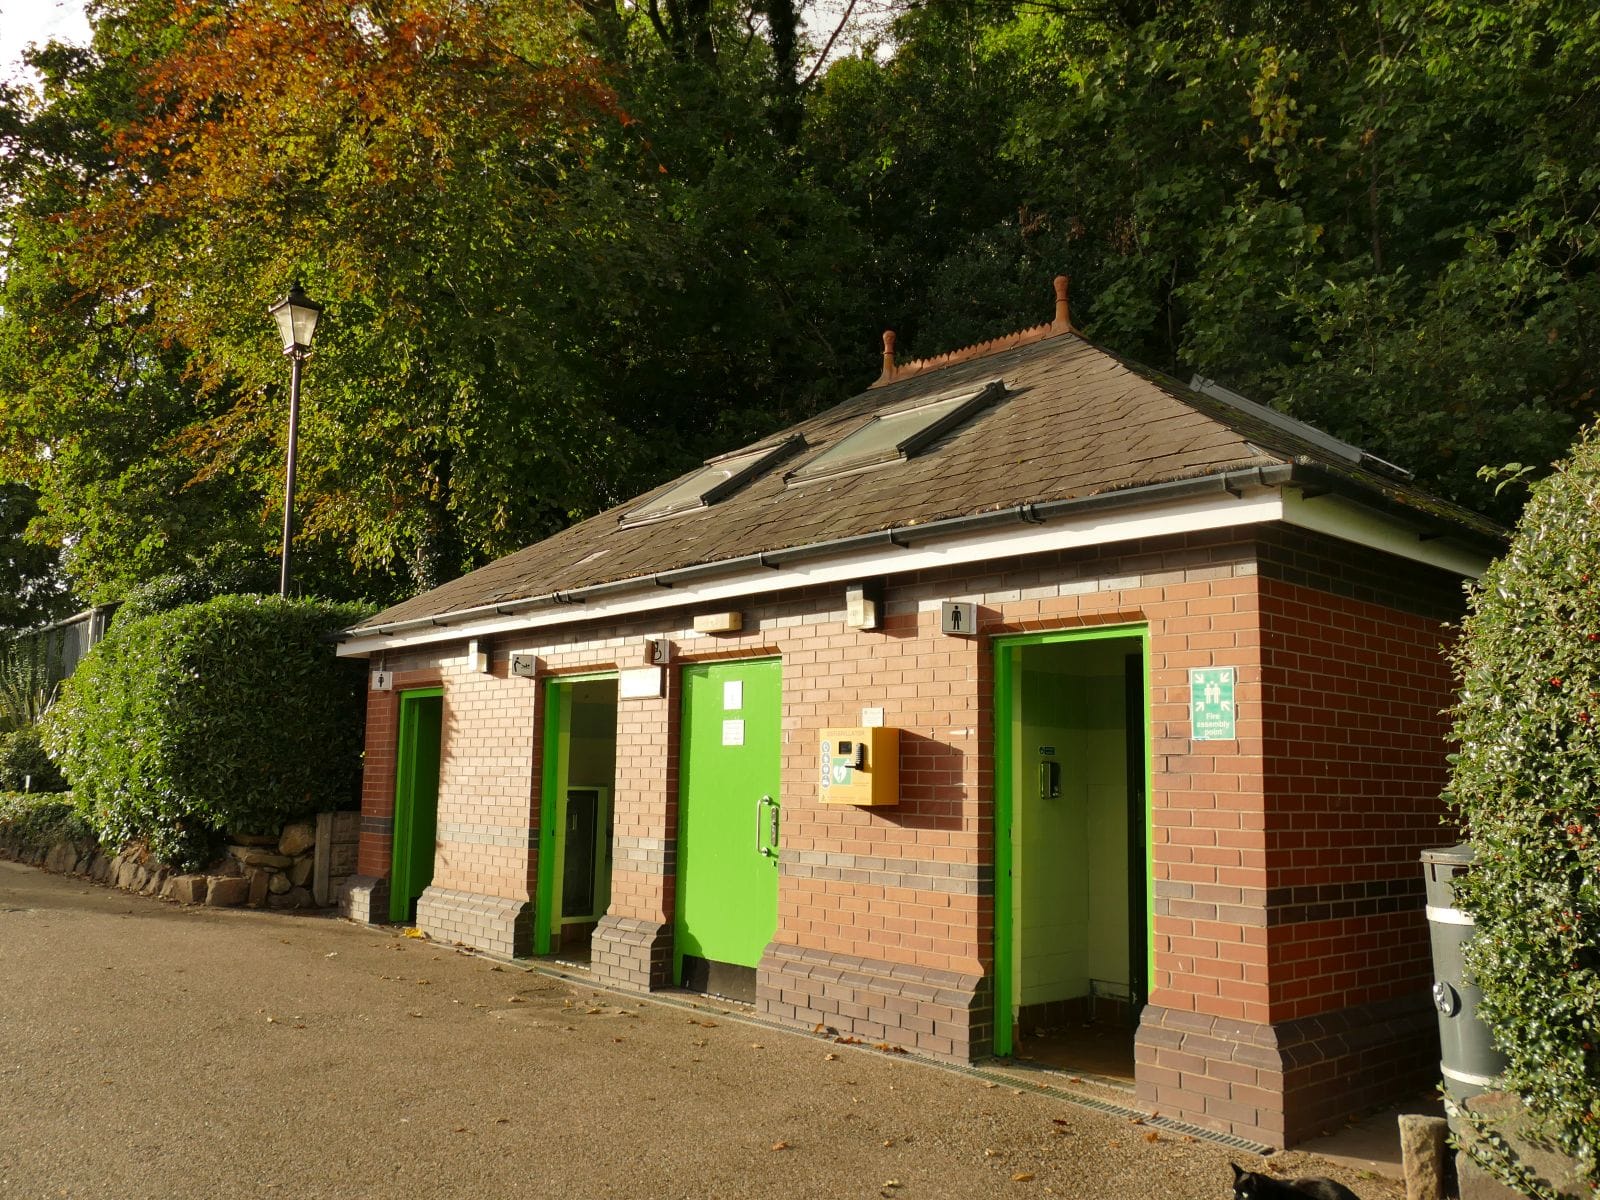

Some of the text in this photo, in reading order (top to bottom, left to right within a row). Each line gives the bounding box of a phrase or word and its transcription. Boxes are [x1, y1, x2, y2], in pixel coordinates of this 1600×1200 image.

[1206, 712, 1221, 720] Fire
[1196, 720, 1230, 729] assembly
[1205, 728, 1222, 737] point
